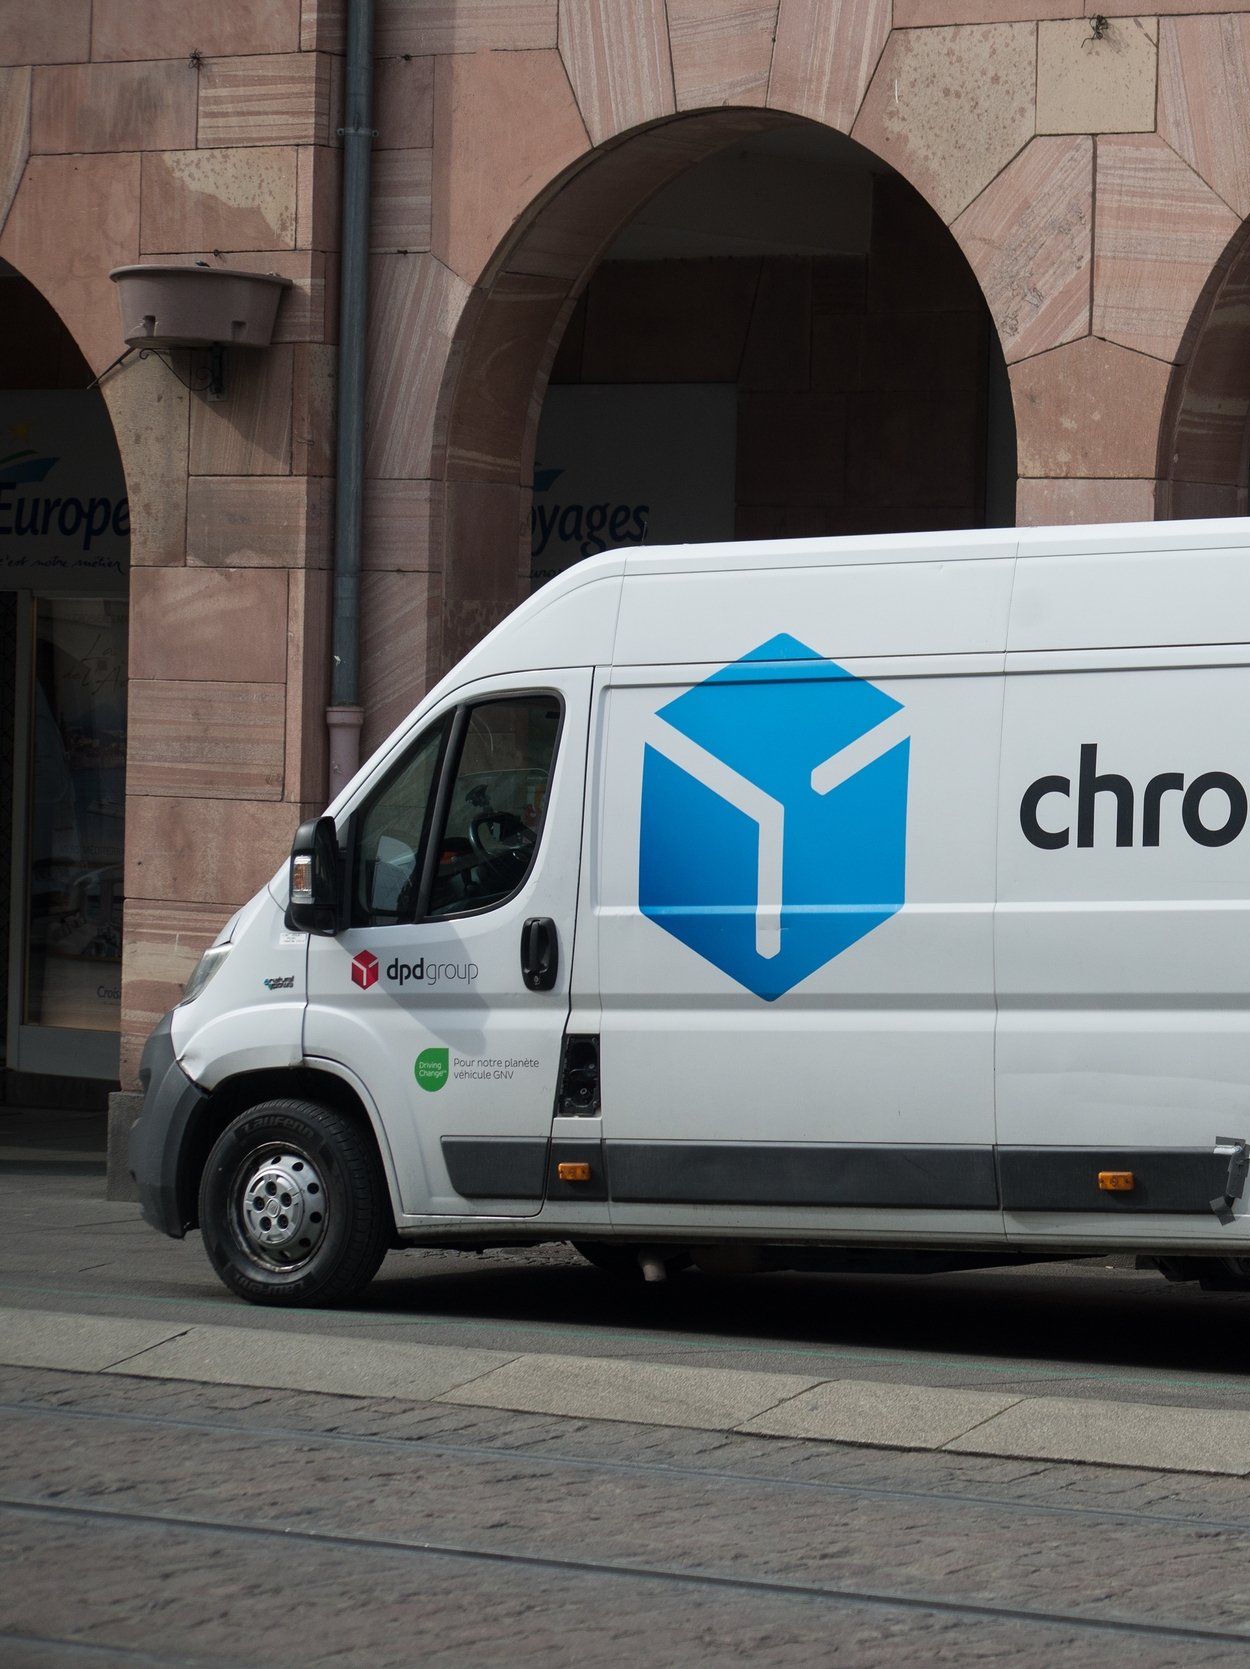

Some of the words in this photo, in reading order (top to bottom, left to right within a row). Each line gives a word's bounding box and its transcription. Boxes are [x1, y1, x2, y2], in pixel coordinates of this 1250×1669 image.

[532, 503, 650, 559] yages
[386, 956, 480, 987] dpdgroup
[418, 1061, 442, 1071] Driving
[454, 1057, 475, 1069] Pour
[477, 1057, 503, 1069] notre
[504, 1057, 540, 1070] planète
[453, 1069, 492, 1081] véhicule
[493, 1069, 515, 1081] GNV
